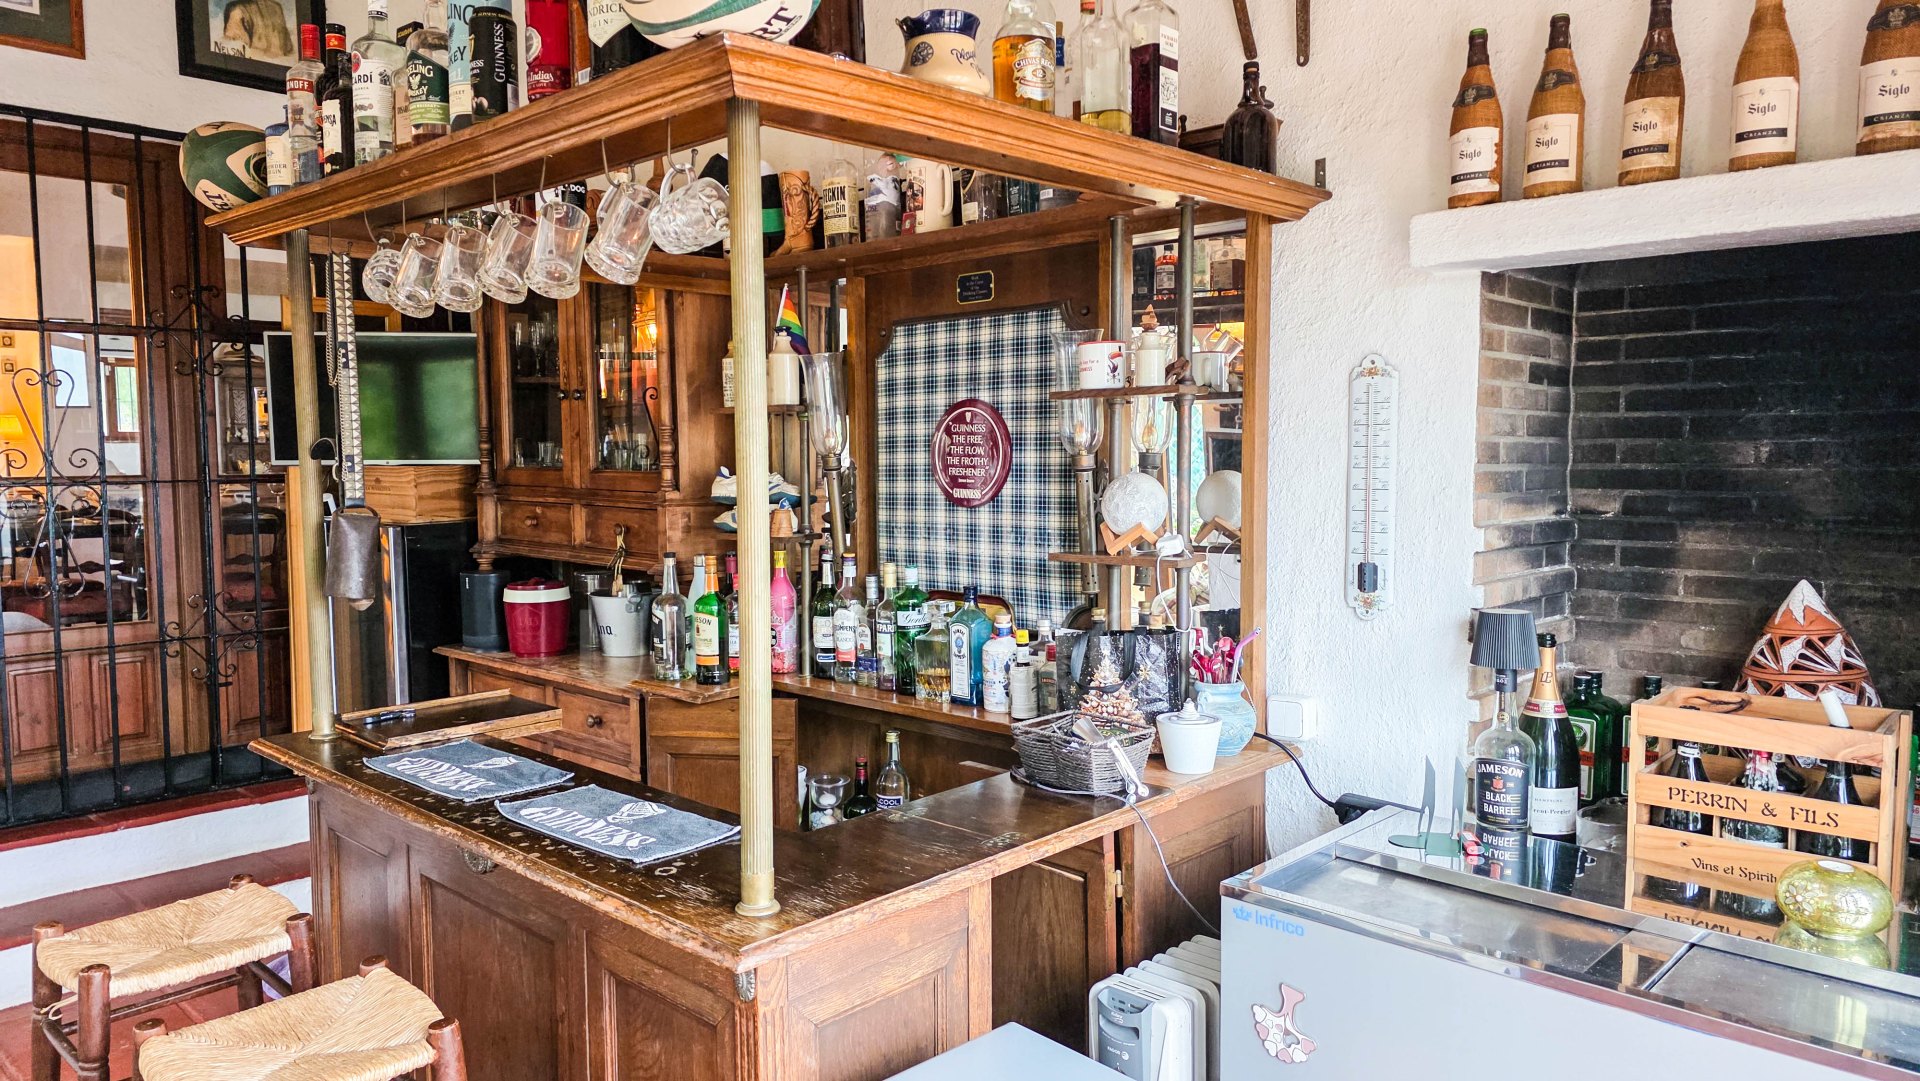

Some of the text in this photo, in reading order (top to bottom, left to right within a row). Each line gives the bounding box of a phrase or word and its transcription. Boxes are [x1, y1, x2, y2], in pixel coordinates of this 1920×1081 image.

[493, 21, 506, 83] GUINNESS
[1015, 57, 1040, 69] CHIVAS
[1877, 84, 1910, 99] Siglo
[1747, 103, 1777, 116] Siglo
[1873, 113, 1910, 122] CRIANZA
[1631, 120, 1658, 133] Siglo
[1743, 130, 1777, 138] CRIANZA
[1535, 136, 1559, 149] Siglo
[1458, 149, 1482, 160] Siglo
[1532, 161, 1559, 169] CRIANZA
[1456, 172, 1483, 181] CRIANZA
[835, 201, 846, 213] Gin
[952, 435, 966, 443] THE
[951, 446, 964, 454] THE
[947, 456, 988, 465] THE FROTHY
[953, 488, 982, 499] GUINNESS
[387, 756, 500, 793] GUINNESS
[1478, 763, 1523, 779] JAMESON
[1485, 791, 1512, 803] BLACK
[1483, 803, 1514, 816] BARREL
[1668, 786, 1840, 829] PERRIN & FILS
[519, 805, 657, 850] GUINNESS
[1690, 858, 1719, 873] Vins
[1723, 864, 1735, 875] et
